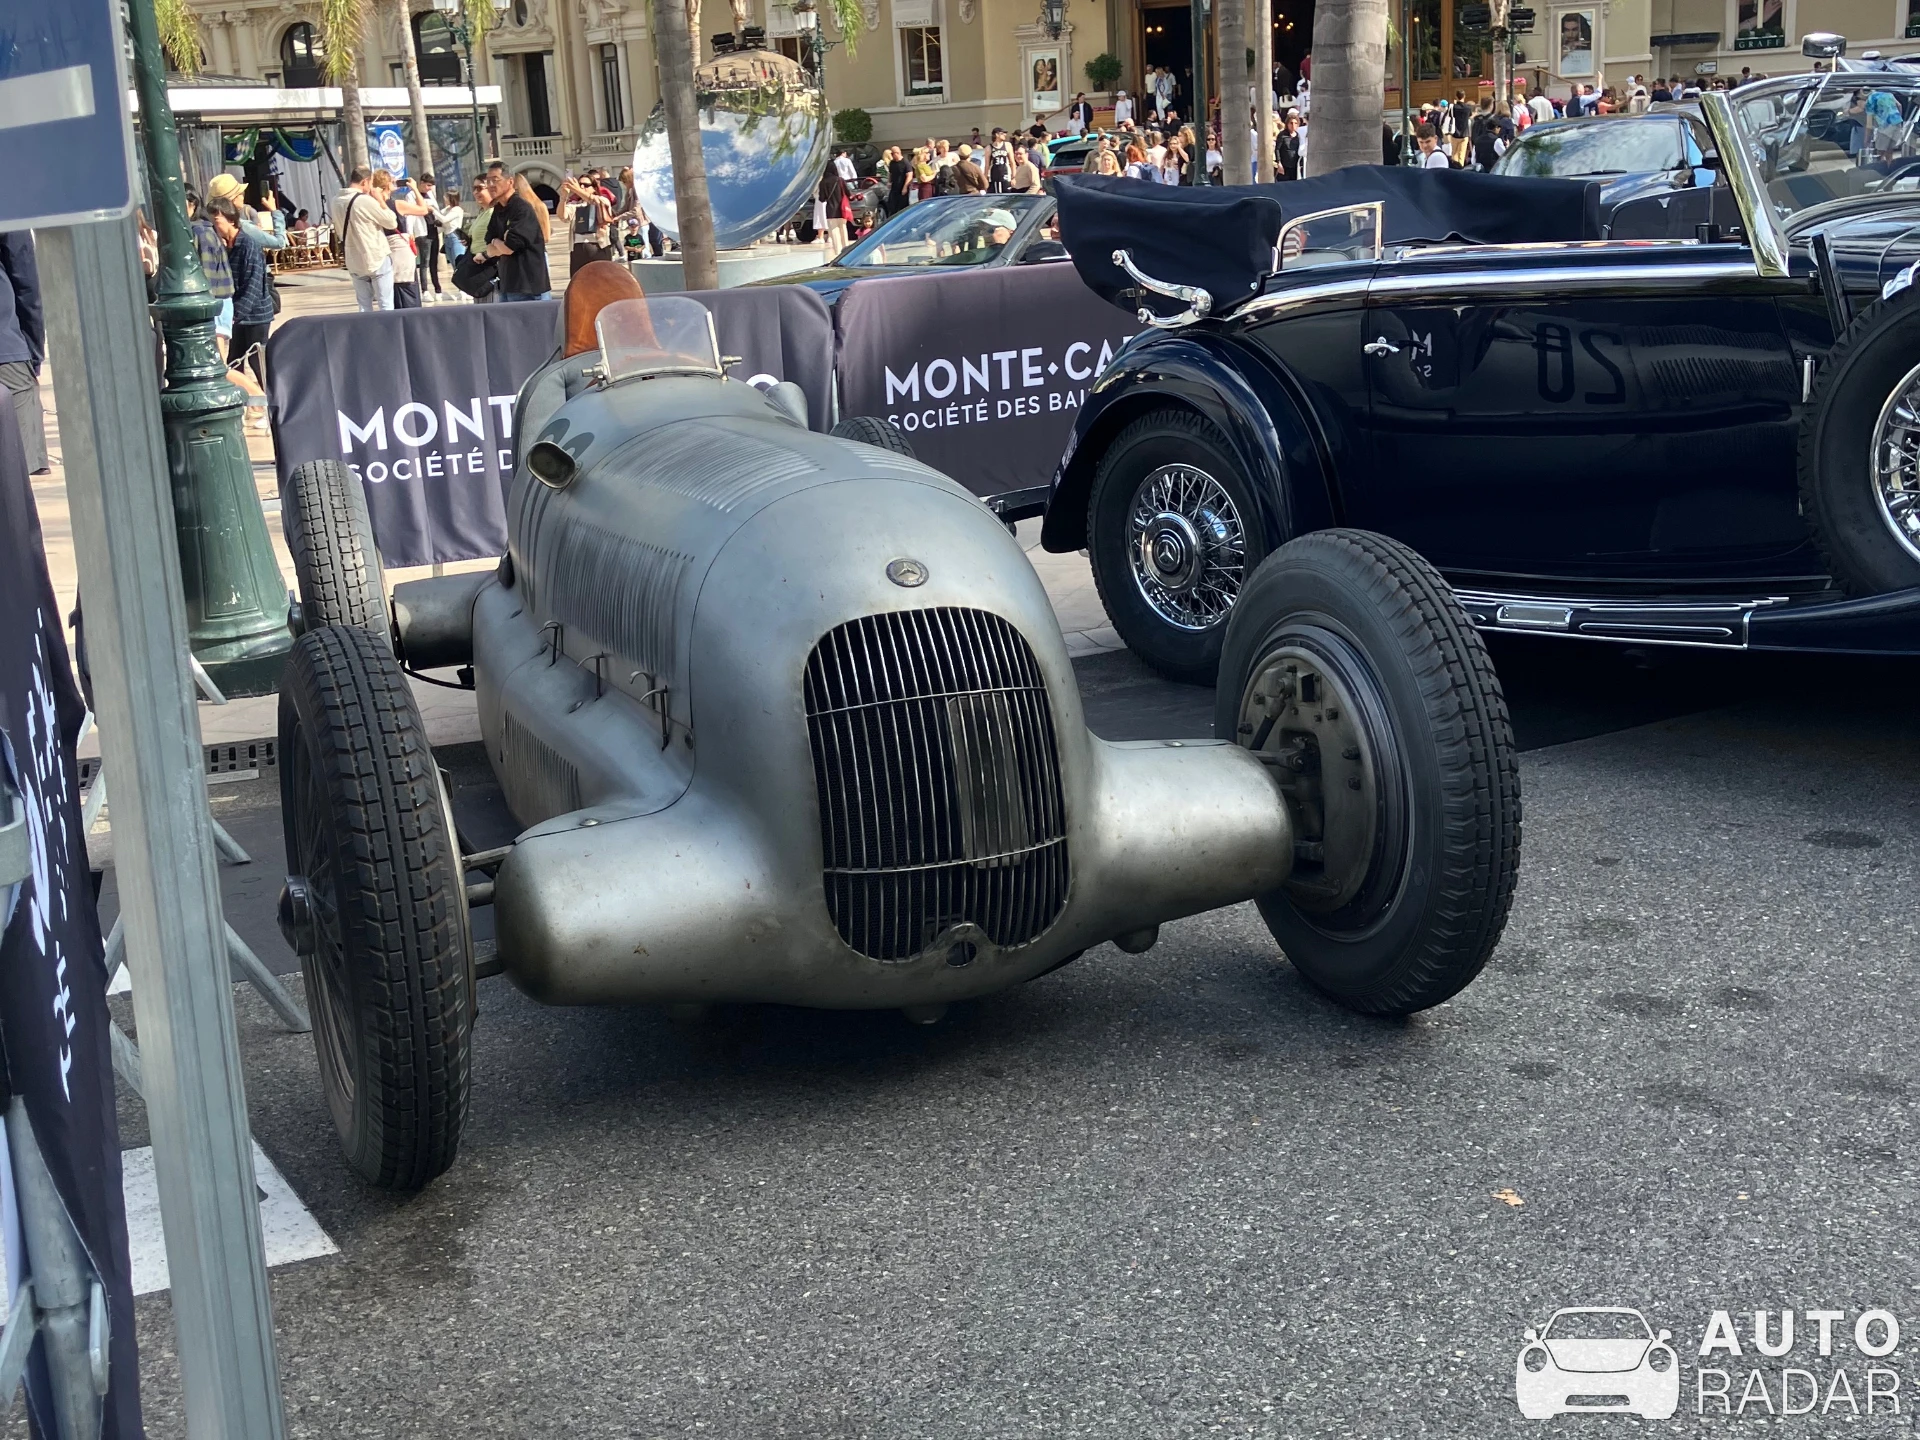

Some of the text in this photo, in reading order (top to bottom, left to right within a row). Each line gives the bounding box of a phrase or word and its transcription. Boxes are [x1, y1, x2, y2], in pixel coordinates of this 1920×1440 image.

[1738, 39, 1781, 49] GRAFF
[337, 394, 517, 454] MONT
[888, 386, 1092, 432] SOCIÉTÉ DES BAI
[347, 446, 485, 483] SOCIÉTÉ
